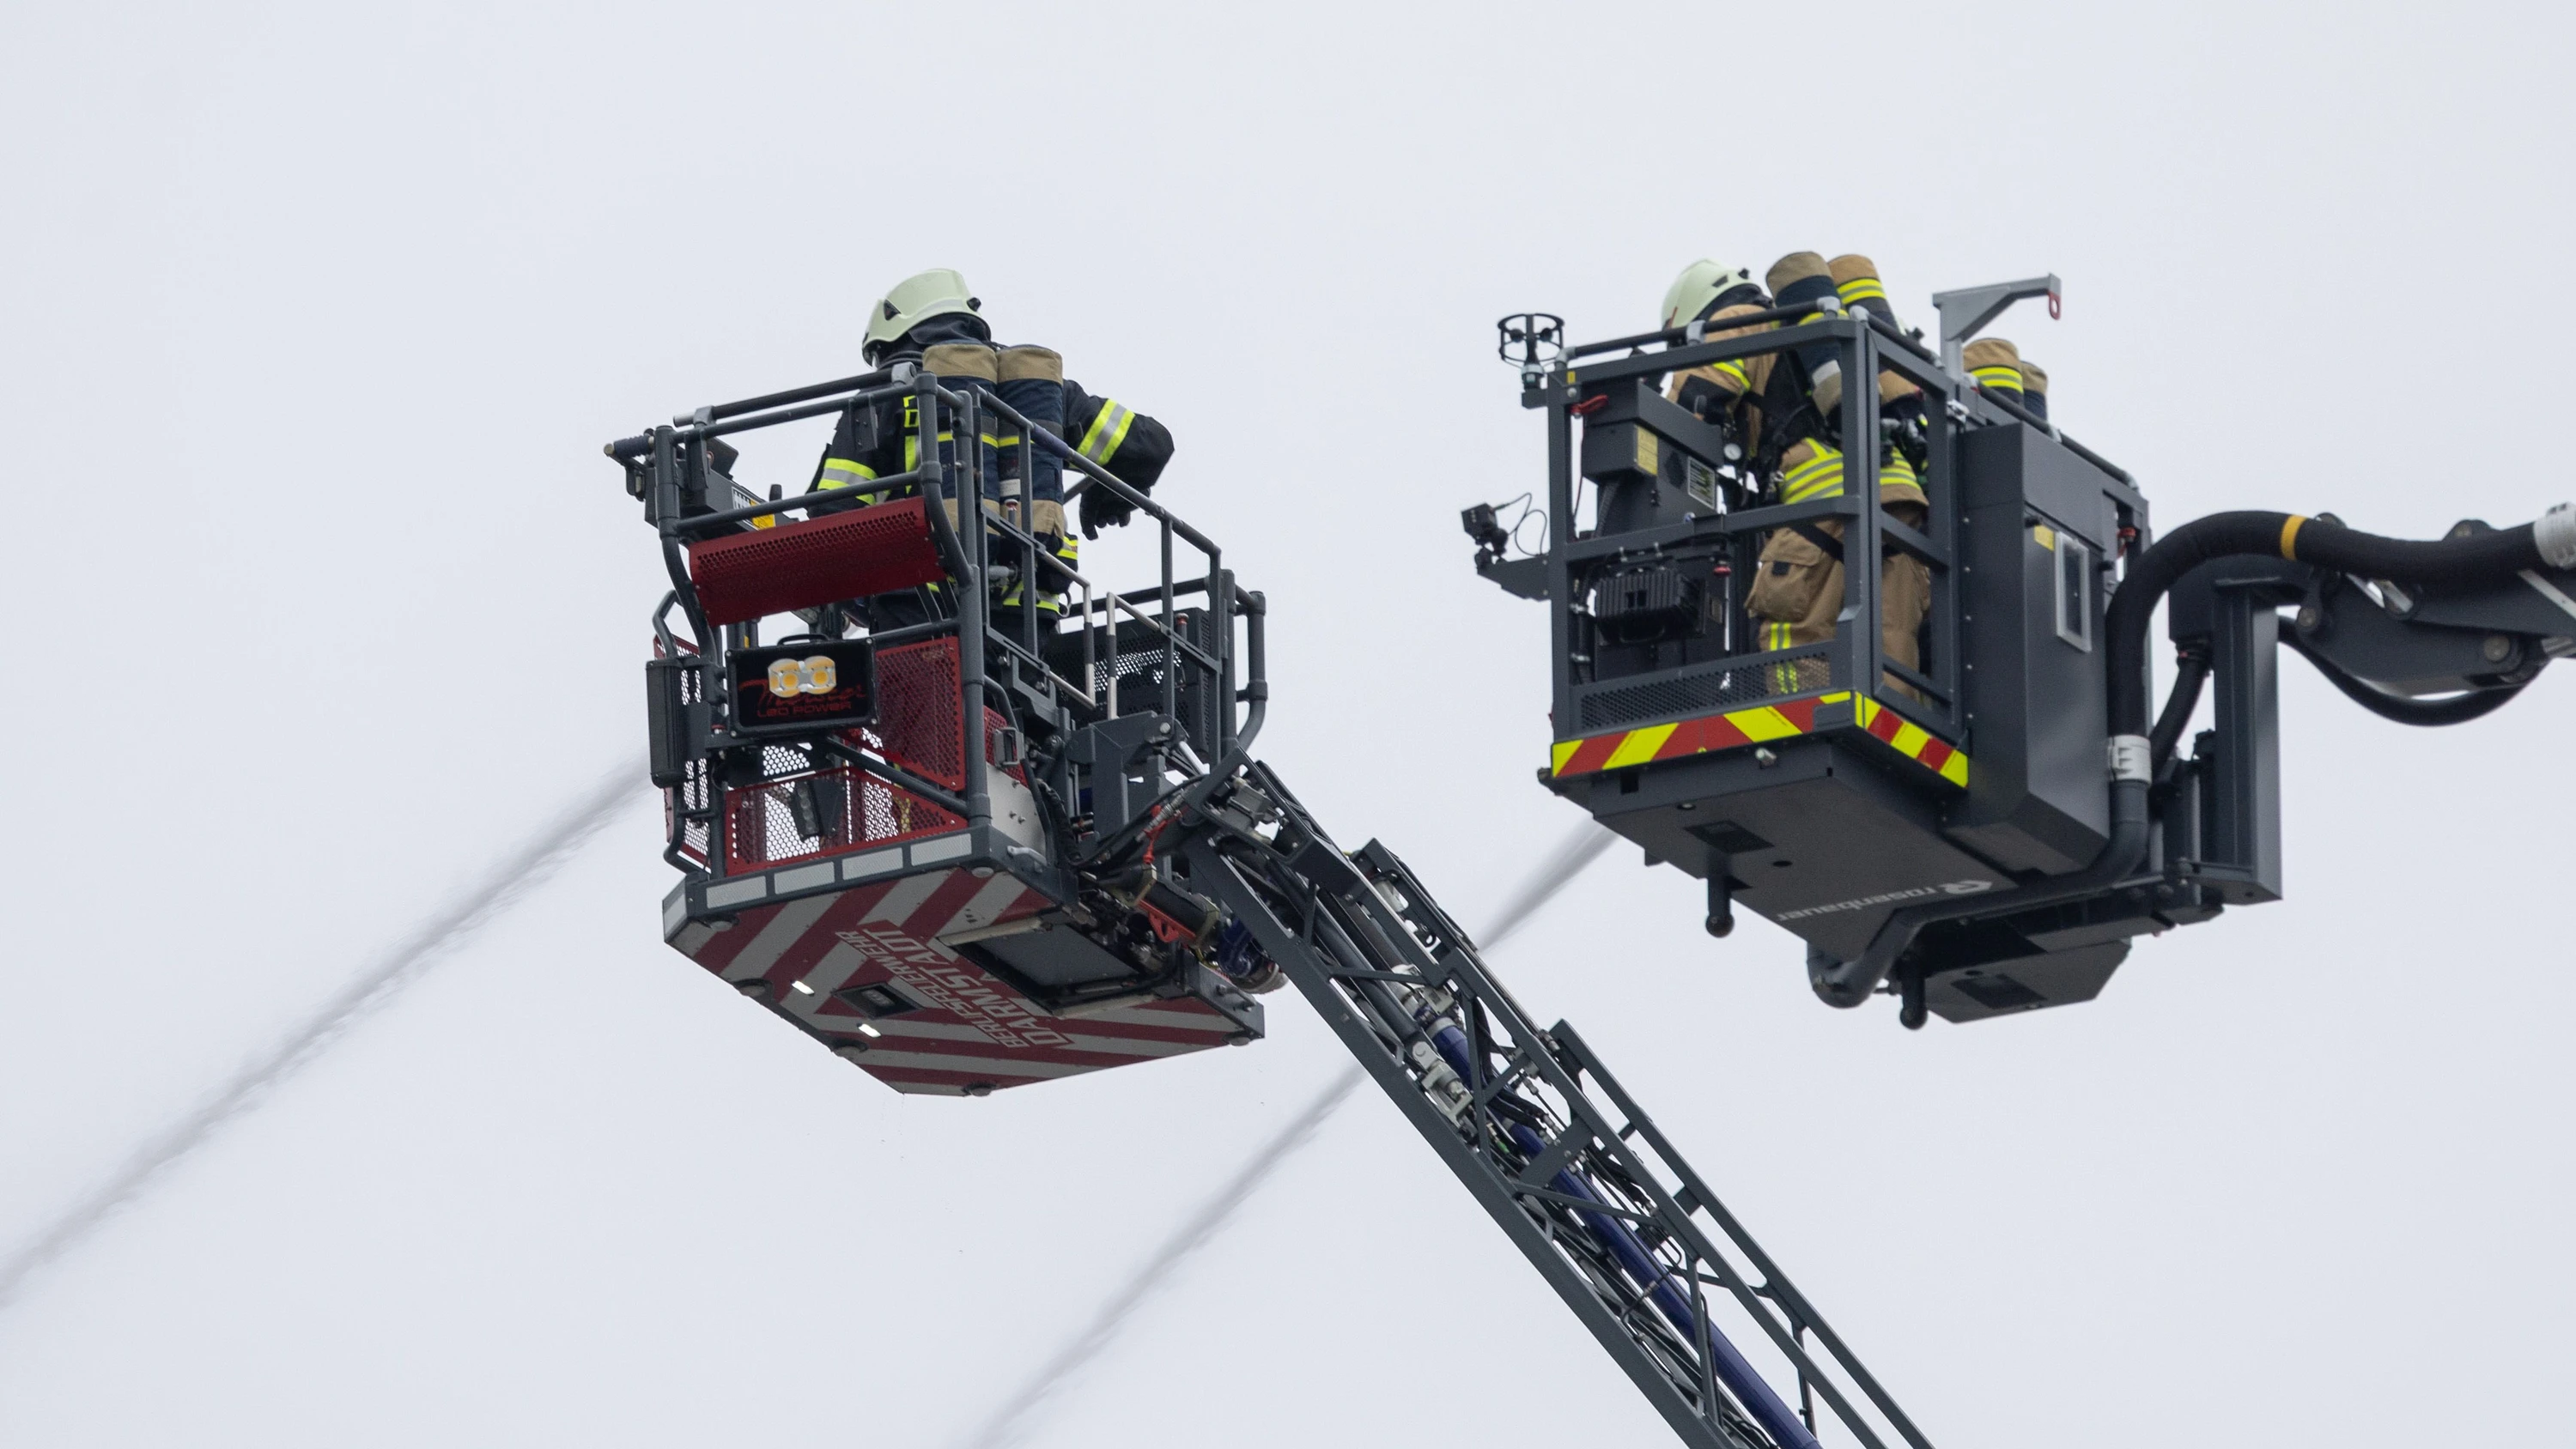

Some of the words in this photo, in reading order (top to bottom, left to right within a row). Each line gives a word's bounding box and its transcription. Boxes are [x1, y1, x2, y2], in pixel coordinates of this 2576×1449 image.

[793, 701, 852, 715] POWER
[1776, 886, 1937, 922] rosenbauer
[835, 930, 1030, 1048] BERUFSFEUERWEHR
[862, 928, 1072, 1046] DARMSTADT
